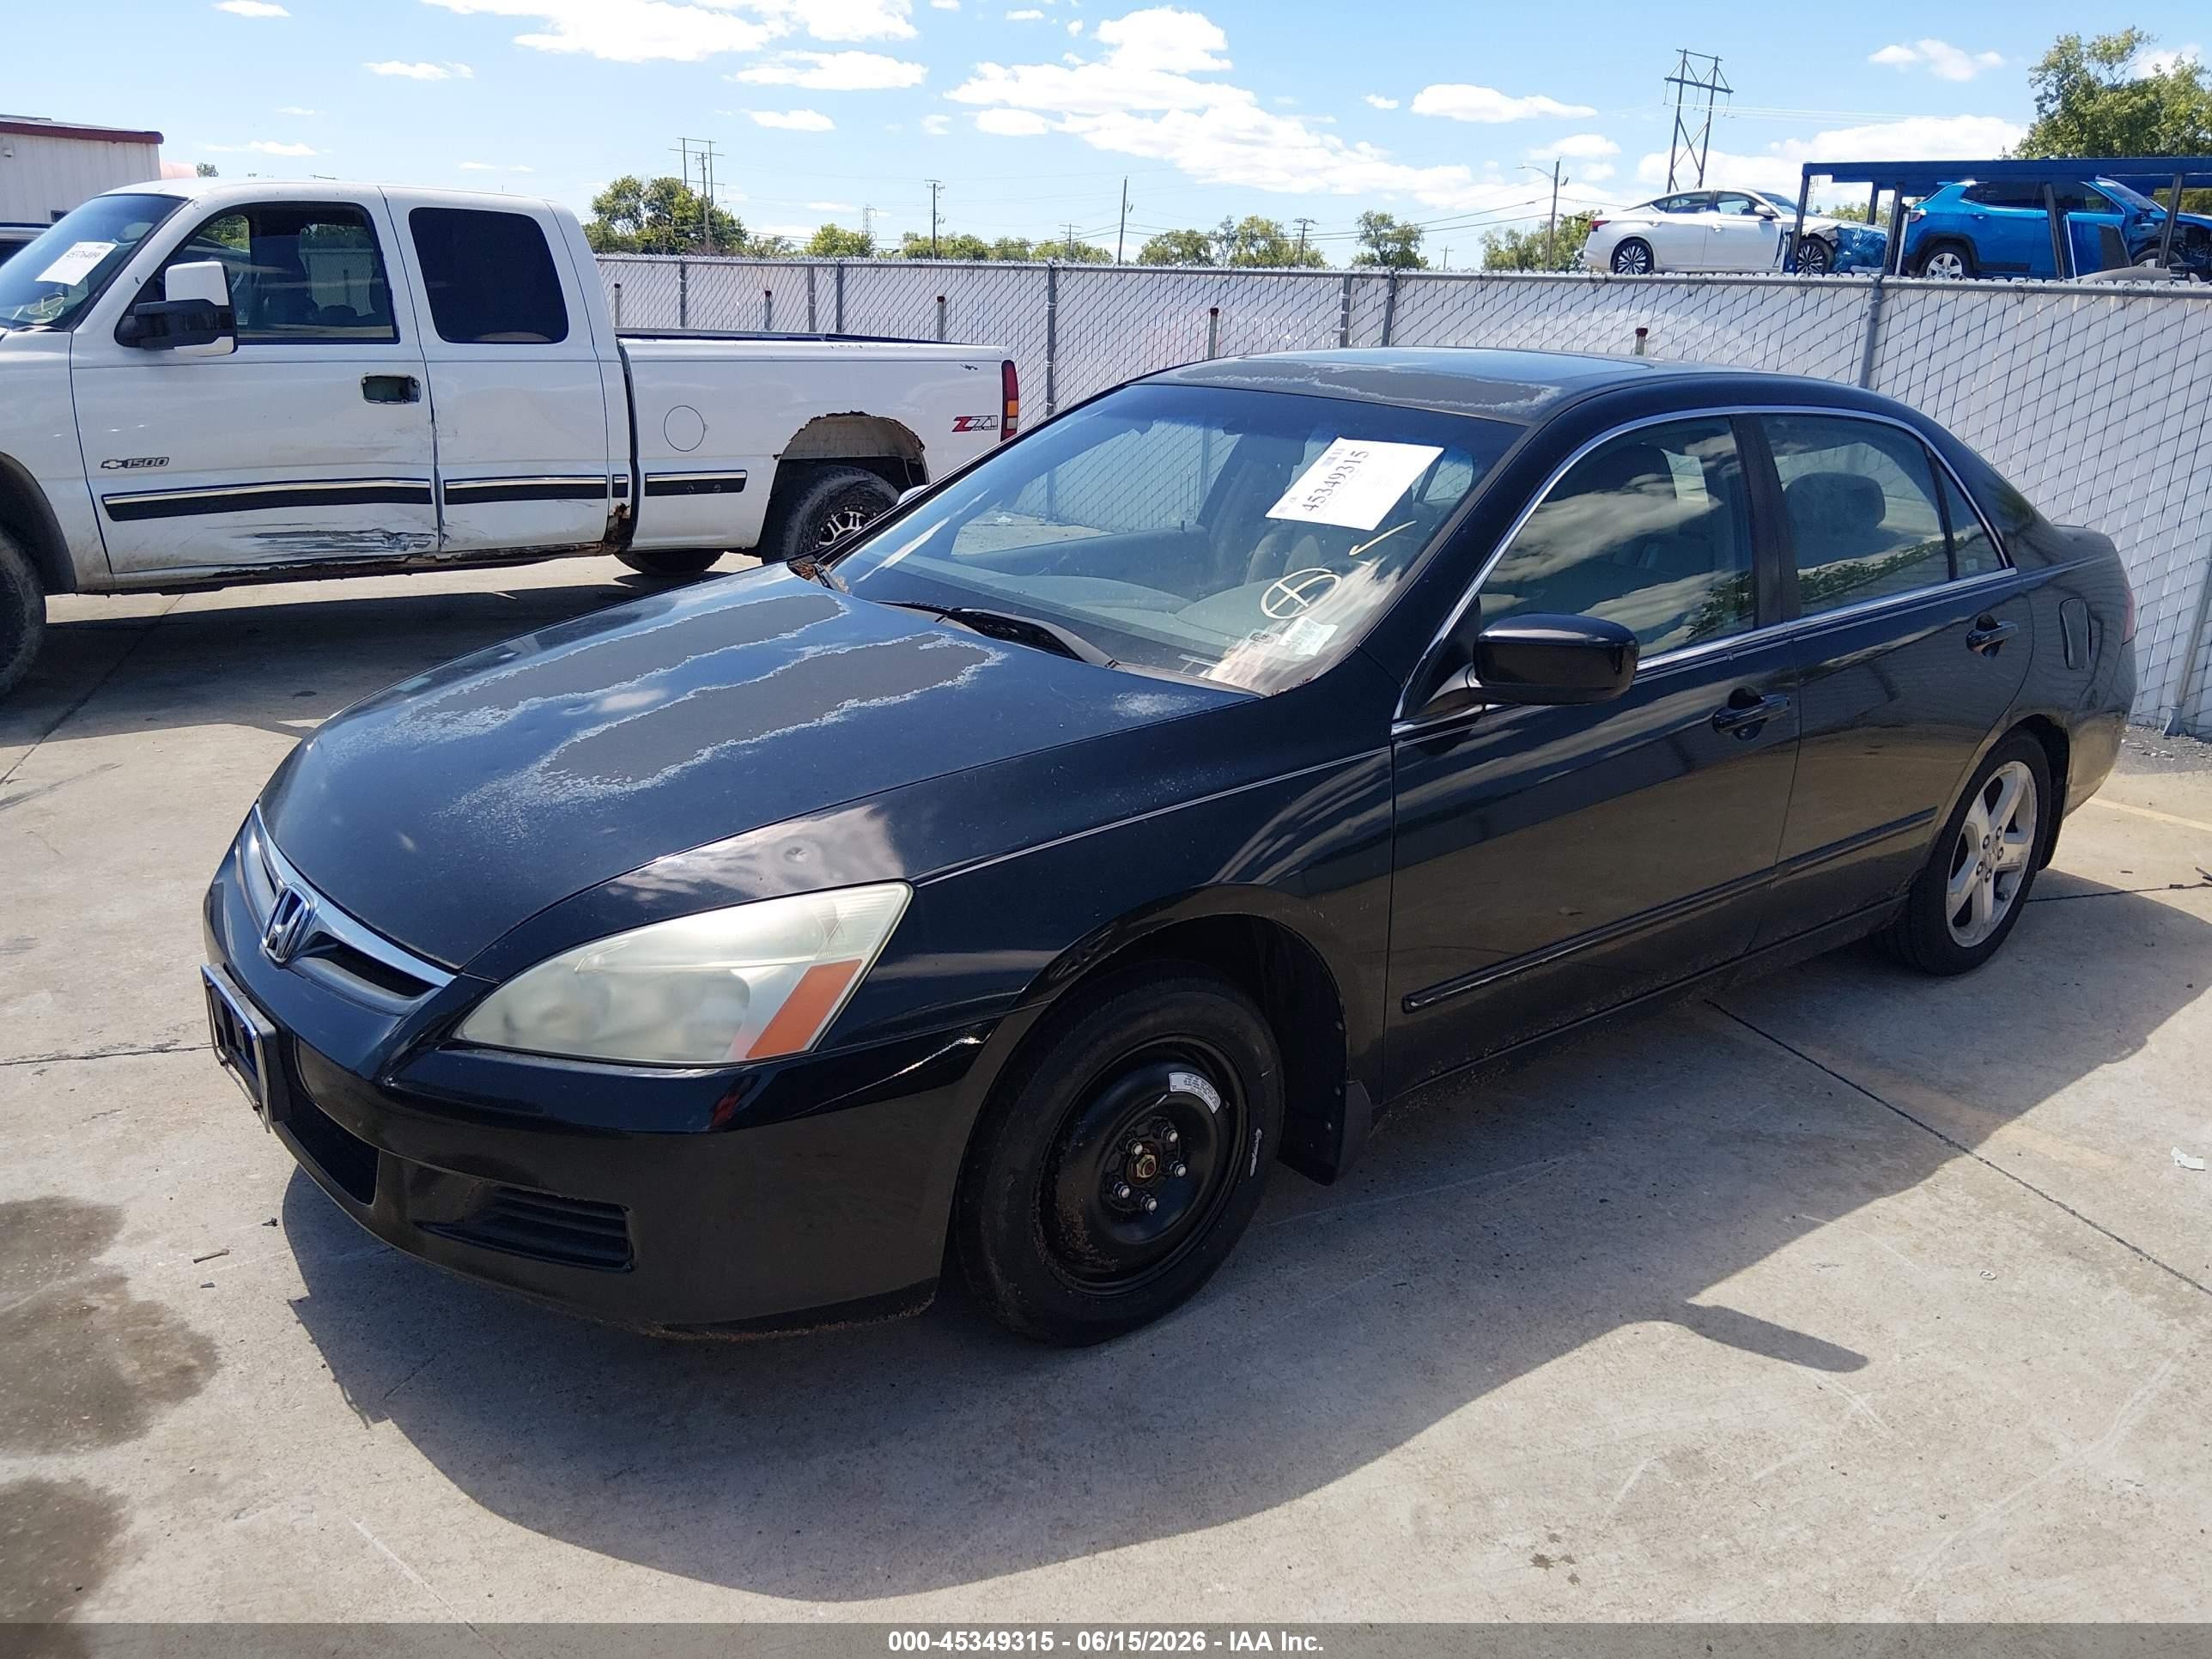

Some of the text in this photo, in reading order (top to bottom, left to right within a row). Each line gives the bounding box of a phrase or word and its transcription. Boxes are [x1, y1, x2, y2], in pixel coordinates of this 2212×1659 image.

[951, 415, 999, 432] Z71
[125, 457, 169, 469] 1500
[1302, 450, 1370, 512] 45349315
